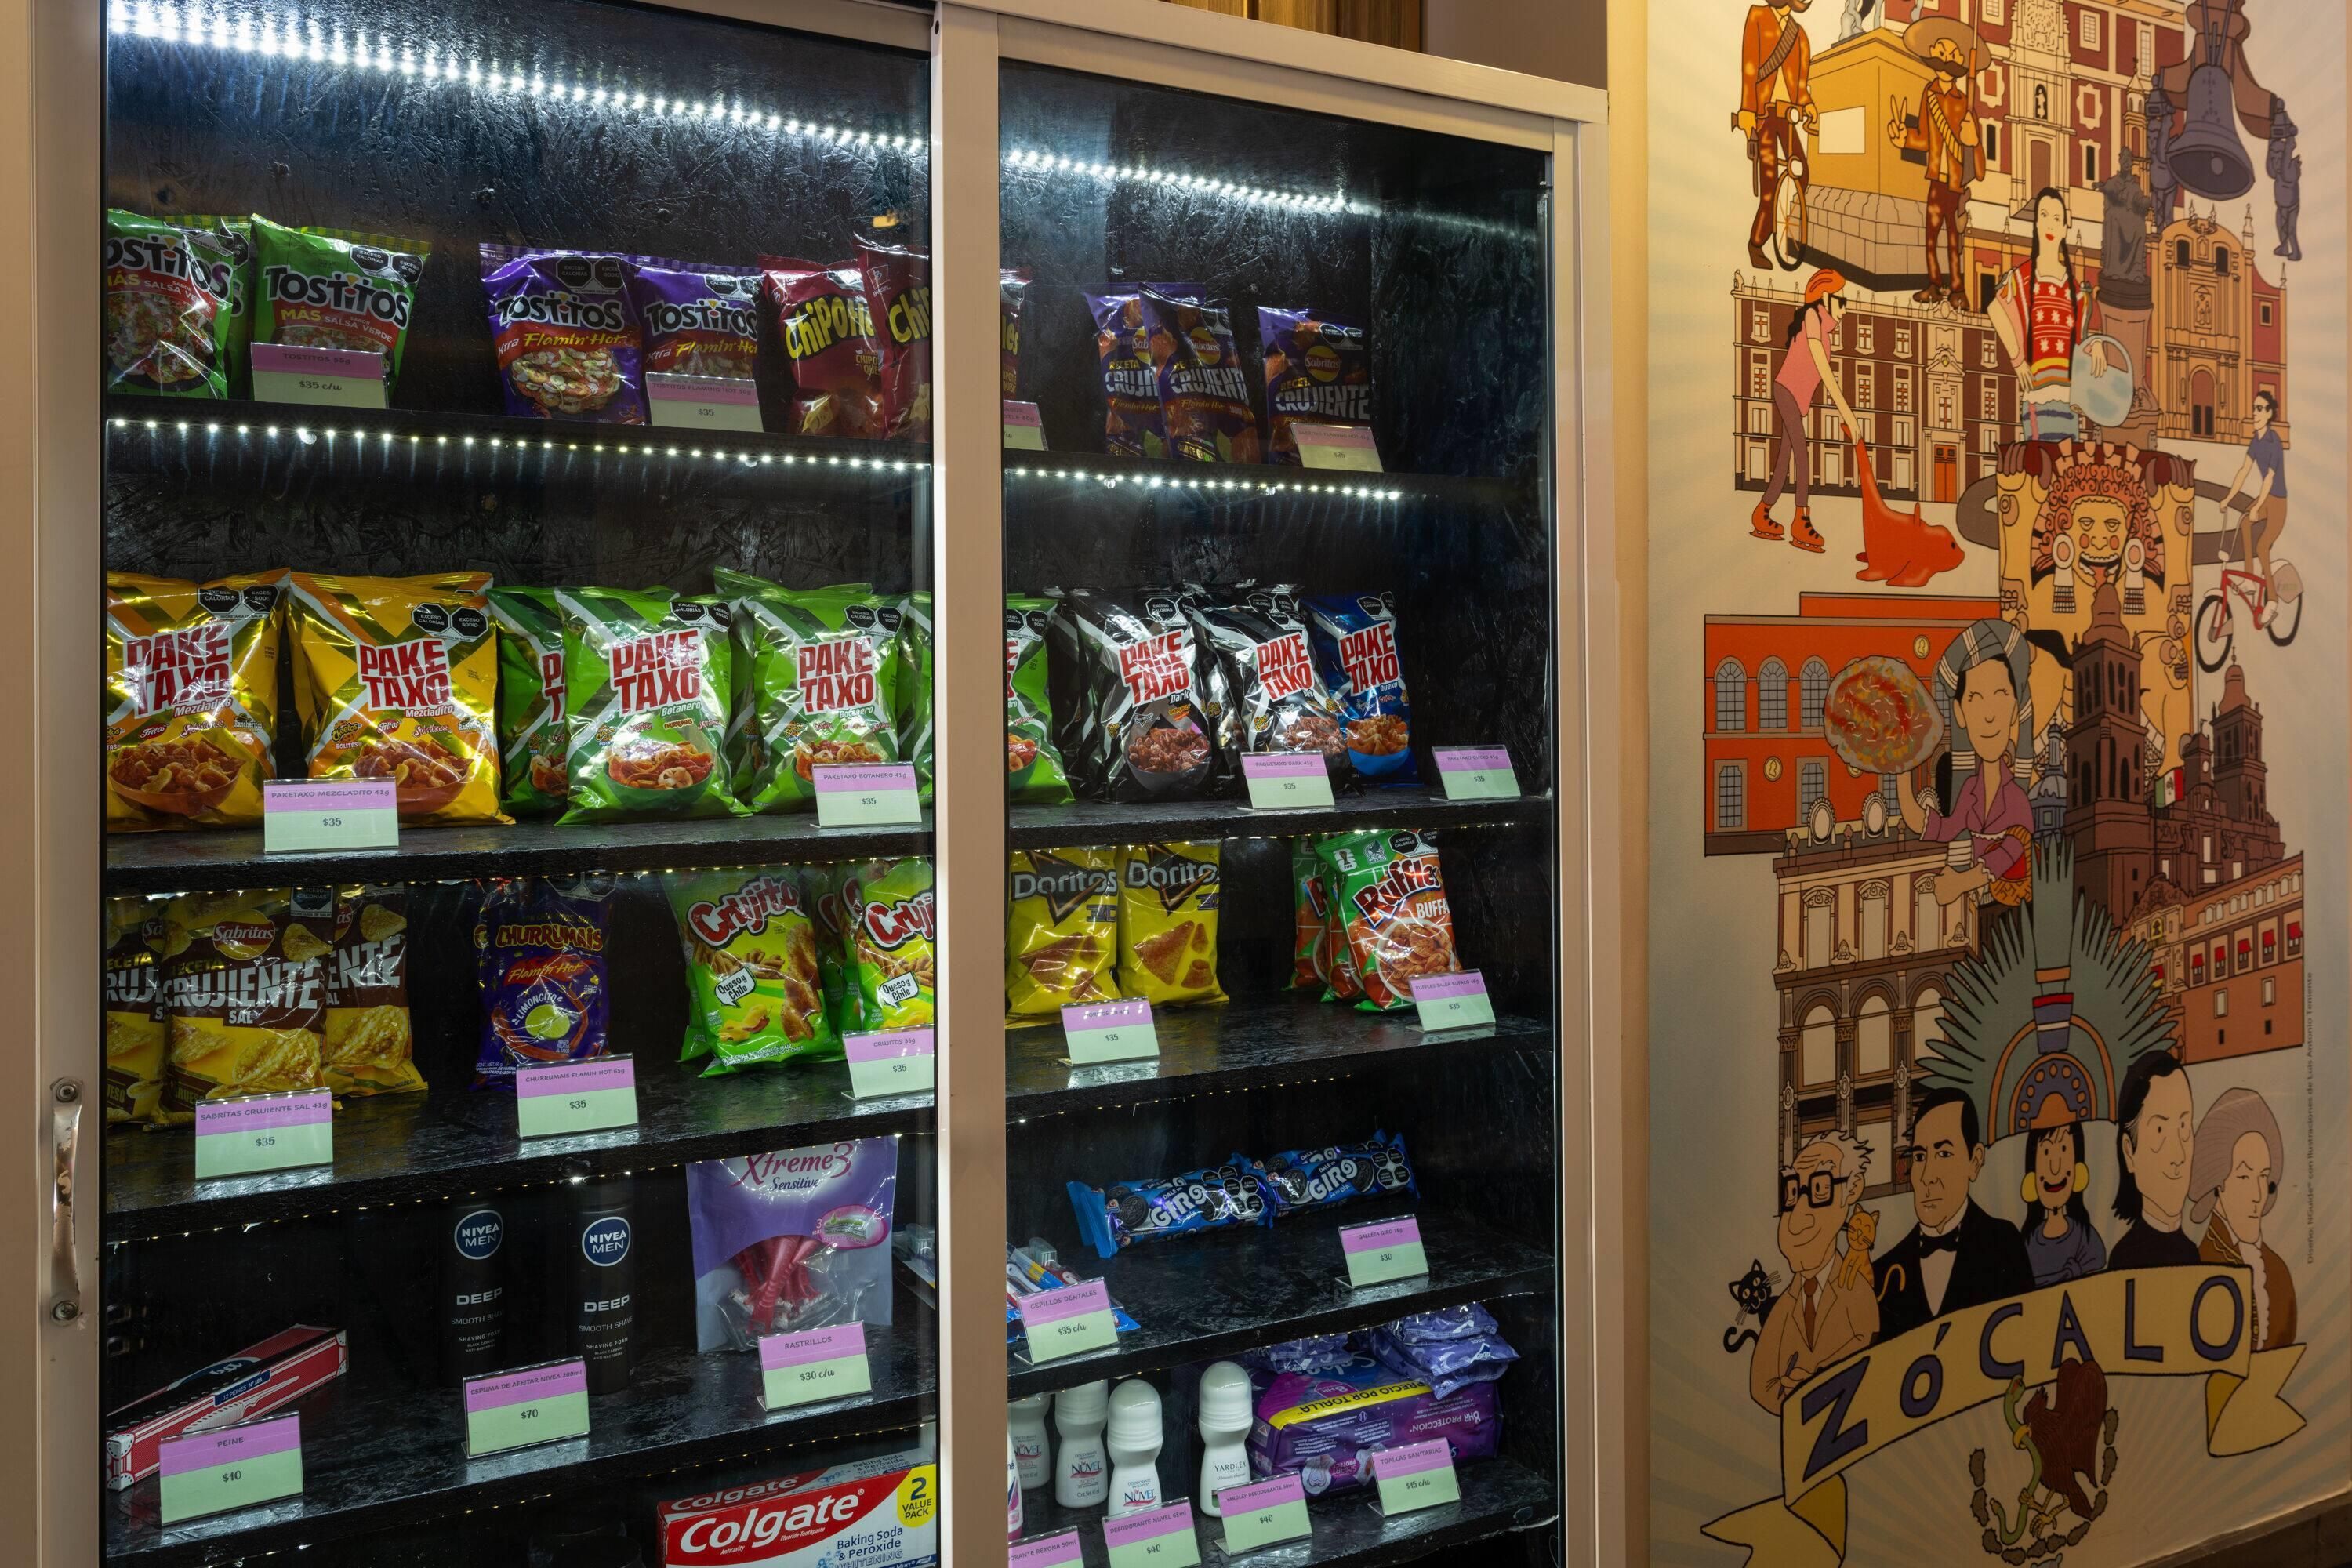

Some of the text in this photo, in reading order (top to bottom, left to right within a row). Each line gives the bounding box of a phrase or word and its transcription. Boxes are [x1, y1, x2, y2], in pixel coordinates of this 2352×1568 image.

[144, 280, 181, 295] SALSA
[281, 306, 321, 321] MÁS
[325, 315, 394, 343] SALSA VERDE
[498, 333, 627, 358] Xtra Hot
[282, 353, 330, 362] TOSTITOS
[646, 349, 672, 362] Xtra
[1305, 357, 1341, 369] Sabritas
[299, 380, 342, 390] $35 c/u
[1276, 383, 1370, 420] CRUJIENTE
[126, 625, 230, 672] PAKE
[1340, 623, 1395, 666] PAKE
[359, 639, 447, 677] PAKE
[612, 630, 699, 678] PAKE
[798, 637, 873, 680] PAKE
[1257, 634, 1309, 674] PAKE
[1260, 663, 1313, 700] TAXO
[1345, 654, 1399, 694] TAXO
[361, 673, 451, 709] TAXO
[614, 666, 701, 715] TAXO
[1124, 662, 1191, 706] TAXO
[800, 673, 875, 713] TAXO
[1170, 691, 1190, 703] Dark
[405, 706, 454, 718] Mezcladito
[661, 701, 702, 717] Botanero
[332, 723, 358, 742] Cheetos
[375, 789, 390, 797] 41g
[322, 817, 342, 826] $35
[1014, 869, 1117, 899] Doritos
[1352, 858, 1441, 929] Ruffles
[212, 924, 274, 942] Sabritas
[557, 963, 584, 974] Hot
[163, 957, 320, 1010] CRUJIENTE
[717, 977, 741, 994] Queso
[883, 980, 903, 994] Queso
[728, 985, 748, 1001] Chile
[892, 989, 911, 1001] Chile
[516, 992, 557, 1020] LIMONCITO
[229, 1010, 253, 1025] SAL
[892, 1064, 907, 1073] $35
[525, 1073, 570, 1083] CHURRUMAIS
[569, 1099, 587, 1109] $35
[201, 1110, 241, 1120] SABRITAS
[245, 1105, 292, 1116] CRUJIENTE
[255, 1137, 276, 1147] $35
[769, 1176, 821, 1192] Sensitive
[1308, 1159, 1358, 1200] GIRO
[1150, 1184, 1207, 1227] GIRO
[462, 1223, 500, 1237] NIVEA
[589, 1229, 627, 1244] NIVEA
[465, 1233, 496, 1247] MEN
[593, 1240, 625, 1254] MEN
[1380, 1253, 1392, 1261] $30
[456, 1287, 503, 1305] DEEP
[584, 1294, 630, 1312] DEEP
[1030, 1290, 1098, 1310] CEPILLOS DENTALES
[451, 1316, 485, 1325] SMOOTH
[579, 1323, 612, 1333] SMOOTH
[1058, 1323, 1087, 1336] $35 c/u
[459, 1334, 485, 1342] SHAVING
[586, 1337, 629, 1349] SHAVING FOAM
[784, 1336, 833, 1350] RASTRILLOS
[470, 1385, 499, 1396] ESPUMA
[512, 1377, 539, 1388] AFEITAR
[540, 1373, 561, 1382] NIVEA
[562, 1369, 583, 1377] 200ml
[800, 1369, 835, 1381] $30 c/u
[1801, 1274, 2245, 1483] ZÓCALO
[229, 1385, 247, 1397] PEINES
[1351, 1388, 1377, 1401] POR
[521, 1408, 539, 1420] $70
[216, 1436, 245, 1447] PEINE
[1381, 1447, 1442, 1465] TOALLAS SANITARIAS
[1214, 1461, 1247, 1472] YARDLEY
[222, 1470, 242, 1482] $10
[1418, 1479, 1431, 1487] c/u
[671, 1476, 796, 1512] Colgate
[910, 1477, 927, 1500] 2
[1226, 1486, 1283, 1502] YARDLEY DESODORANTE
[902, 1498, 932, 1512] VALUE
[905, 1509, 929, 1520] PACK
[1259, 1514, 1273, 1524] $40
[680, 1493, 859, 1554] Colgate
[1109, 1514, 1172, 1534] DESODORANTE NUVEL
[780, 1526, 826, 1541] Fluoride Toothpaste
[837, 1526, 904, 1550] Baking Soda
[720, 1545, 746, 1555] Anticavity
[838, 1539, 902, 1561] & Peroxide
[1036, 1539, 1076, 1555] REXONA 50ml
[1146, 1544, 1161, 1554] $40
